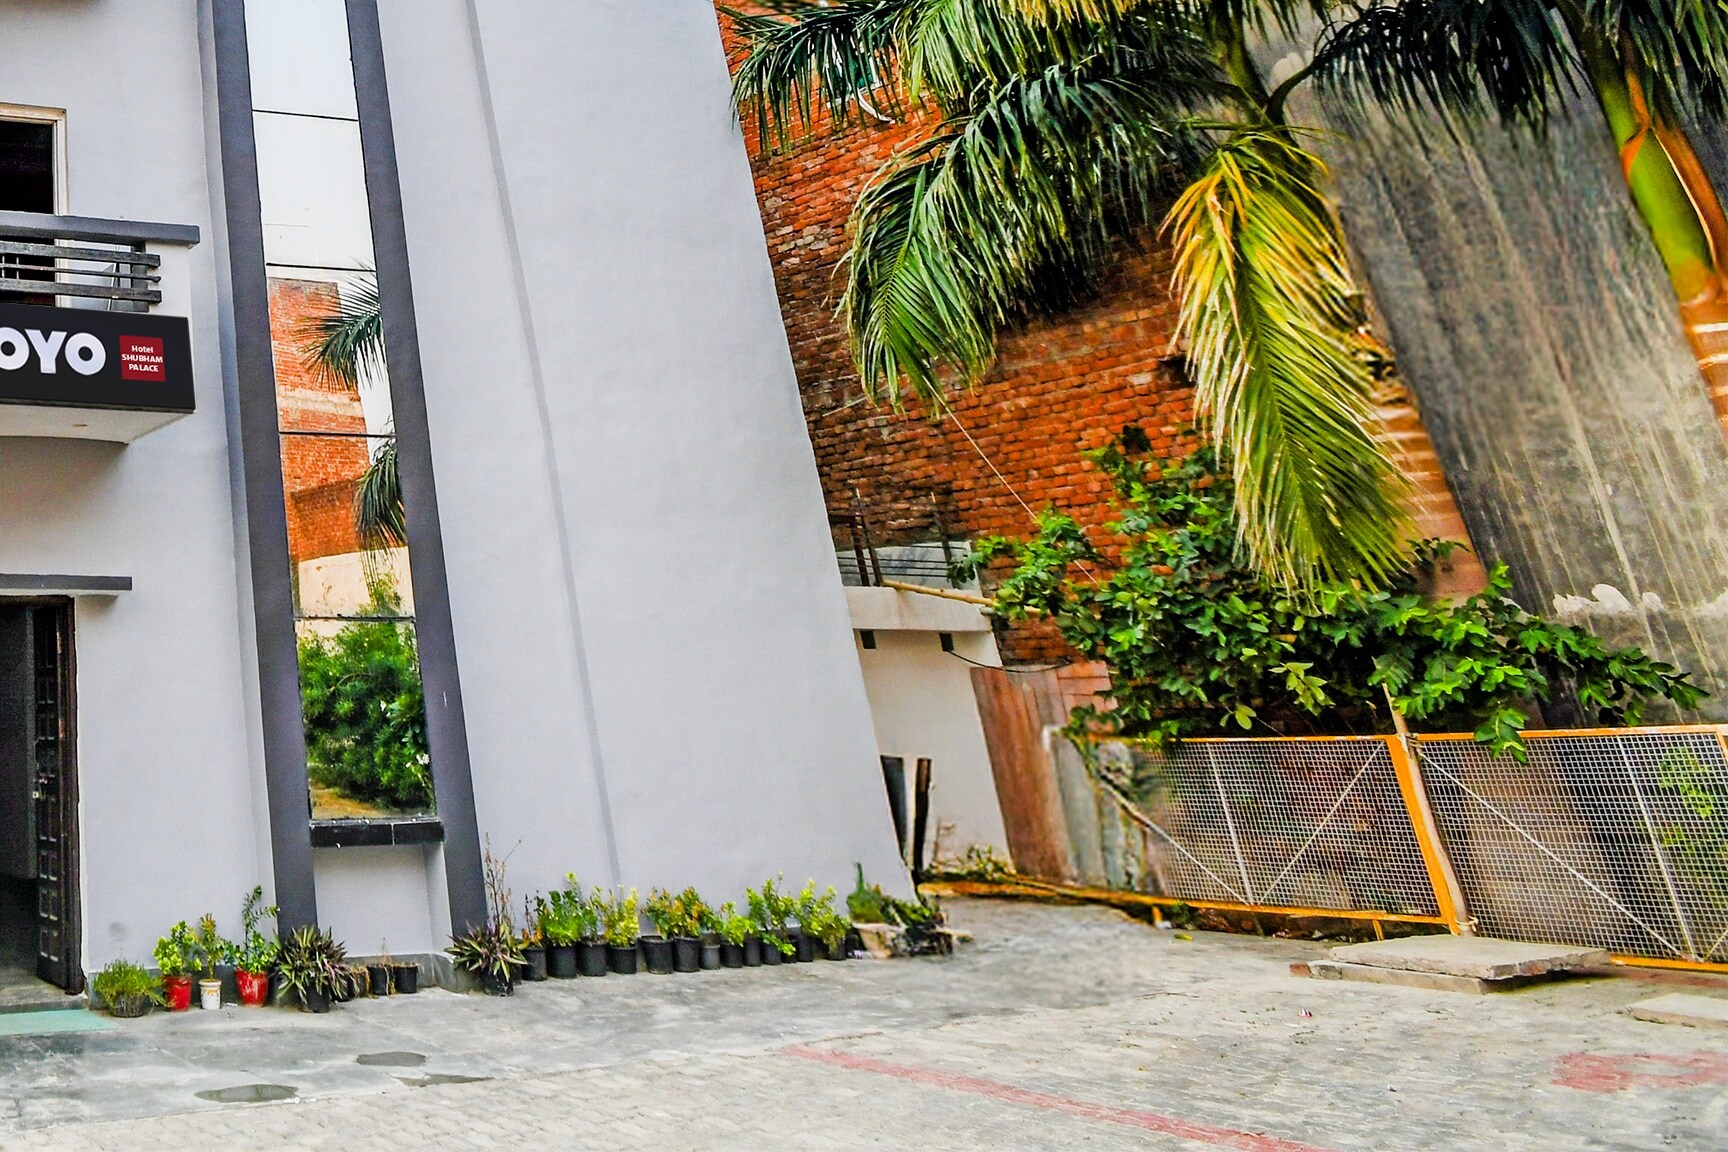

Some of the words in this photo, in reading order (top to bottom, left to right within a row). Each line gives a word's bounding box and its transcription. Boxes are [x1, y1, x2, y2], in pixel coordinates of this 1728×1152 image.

[131, 345, 154, 353] Hotel
[121, 353, 163, 363] SHUBHAM
[128, 363, 159, 372] PALACE
